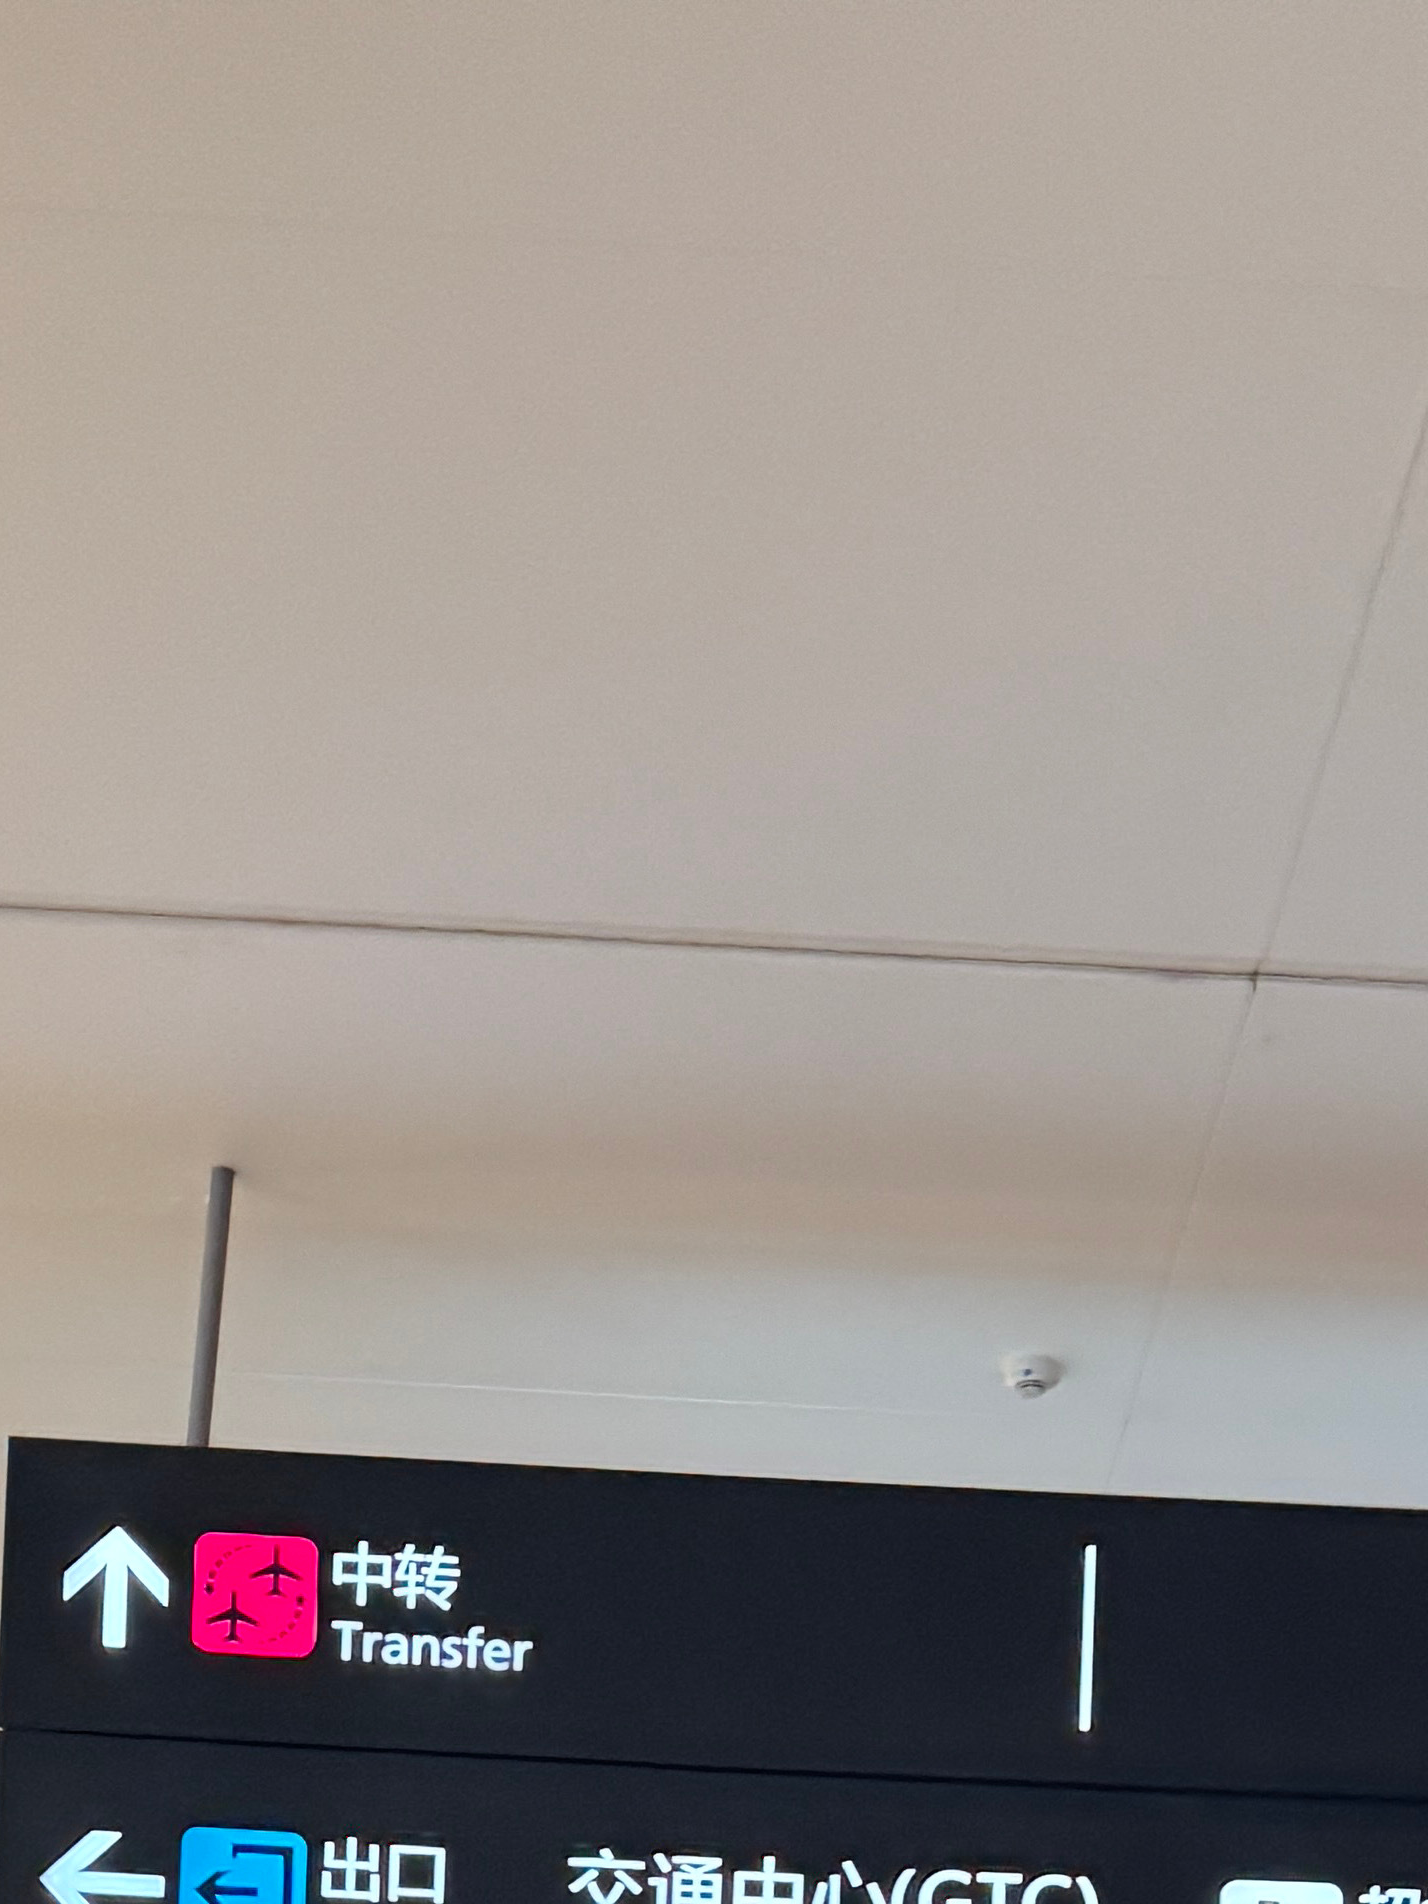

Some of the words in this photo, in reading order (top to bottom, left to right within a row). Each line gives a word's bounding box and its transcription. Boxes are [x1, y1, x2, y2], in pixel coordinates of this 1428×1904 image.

[331, 1540, 461, 1611] 中转
[330, 1619, 534, 1672] Transfer
[321, 1836, 446, 1904] 出口
